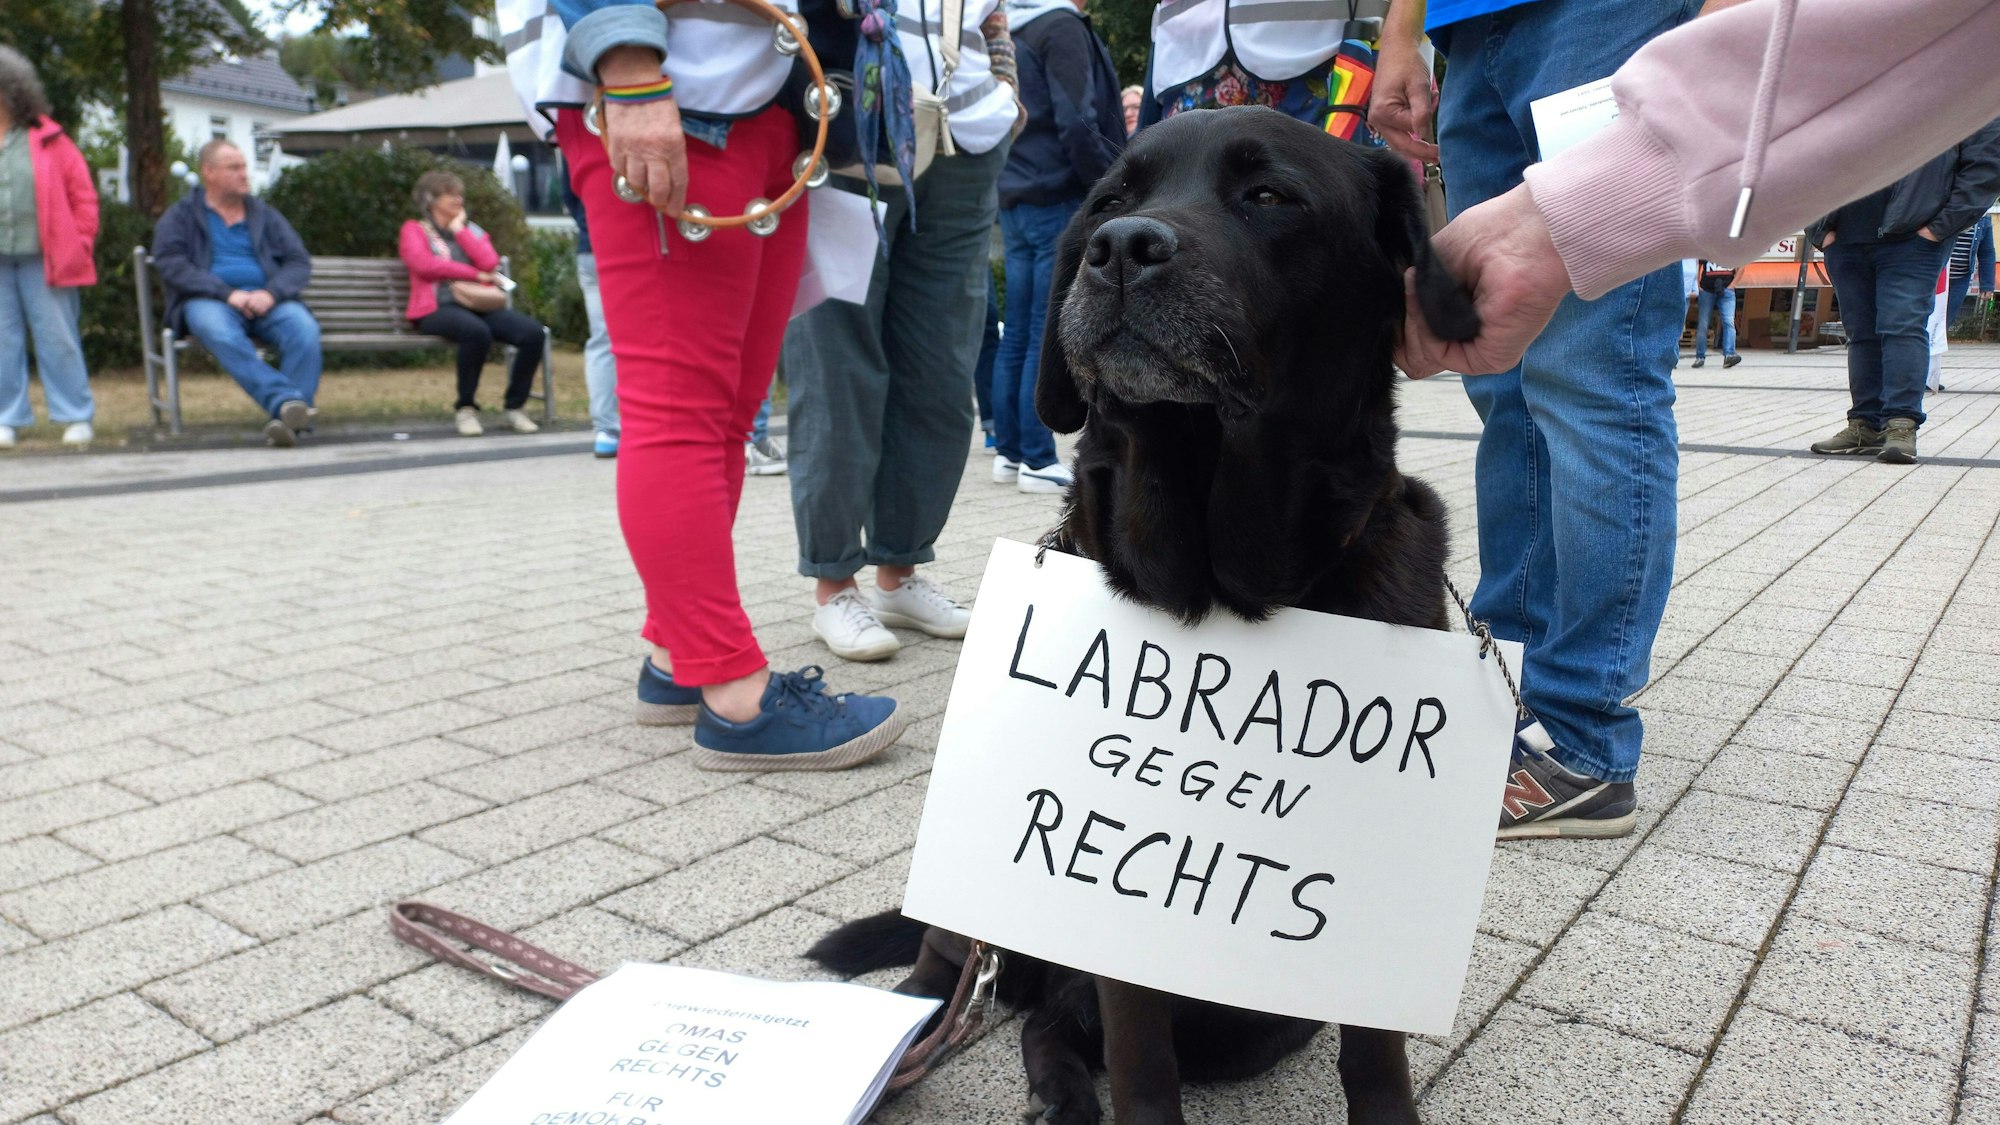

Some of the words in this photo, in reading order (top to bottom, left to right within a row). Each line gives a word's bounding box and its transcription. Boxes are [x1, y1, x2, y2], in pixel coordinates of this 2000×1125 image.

[1008, 603, 1448, 779] LABRADOR
[1088, 733, 1311, 819] GEGEN
[1012, 787, 1336, 942] RECHTS
[665, 1022, 748, 1044] OMAS
[638, 1039, 740, 1067] GEGEN
[609, 1057, 727, 1089] RECHTS
[530, 1111, 664, 1125] DEMOKR
